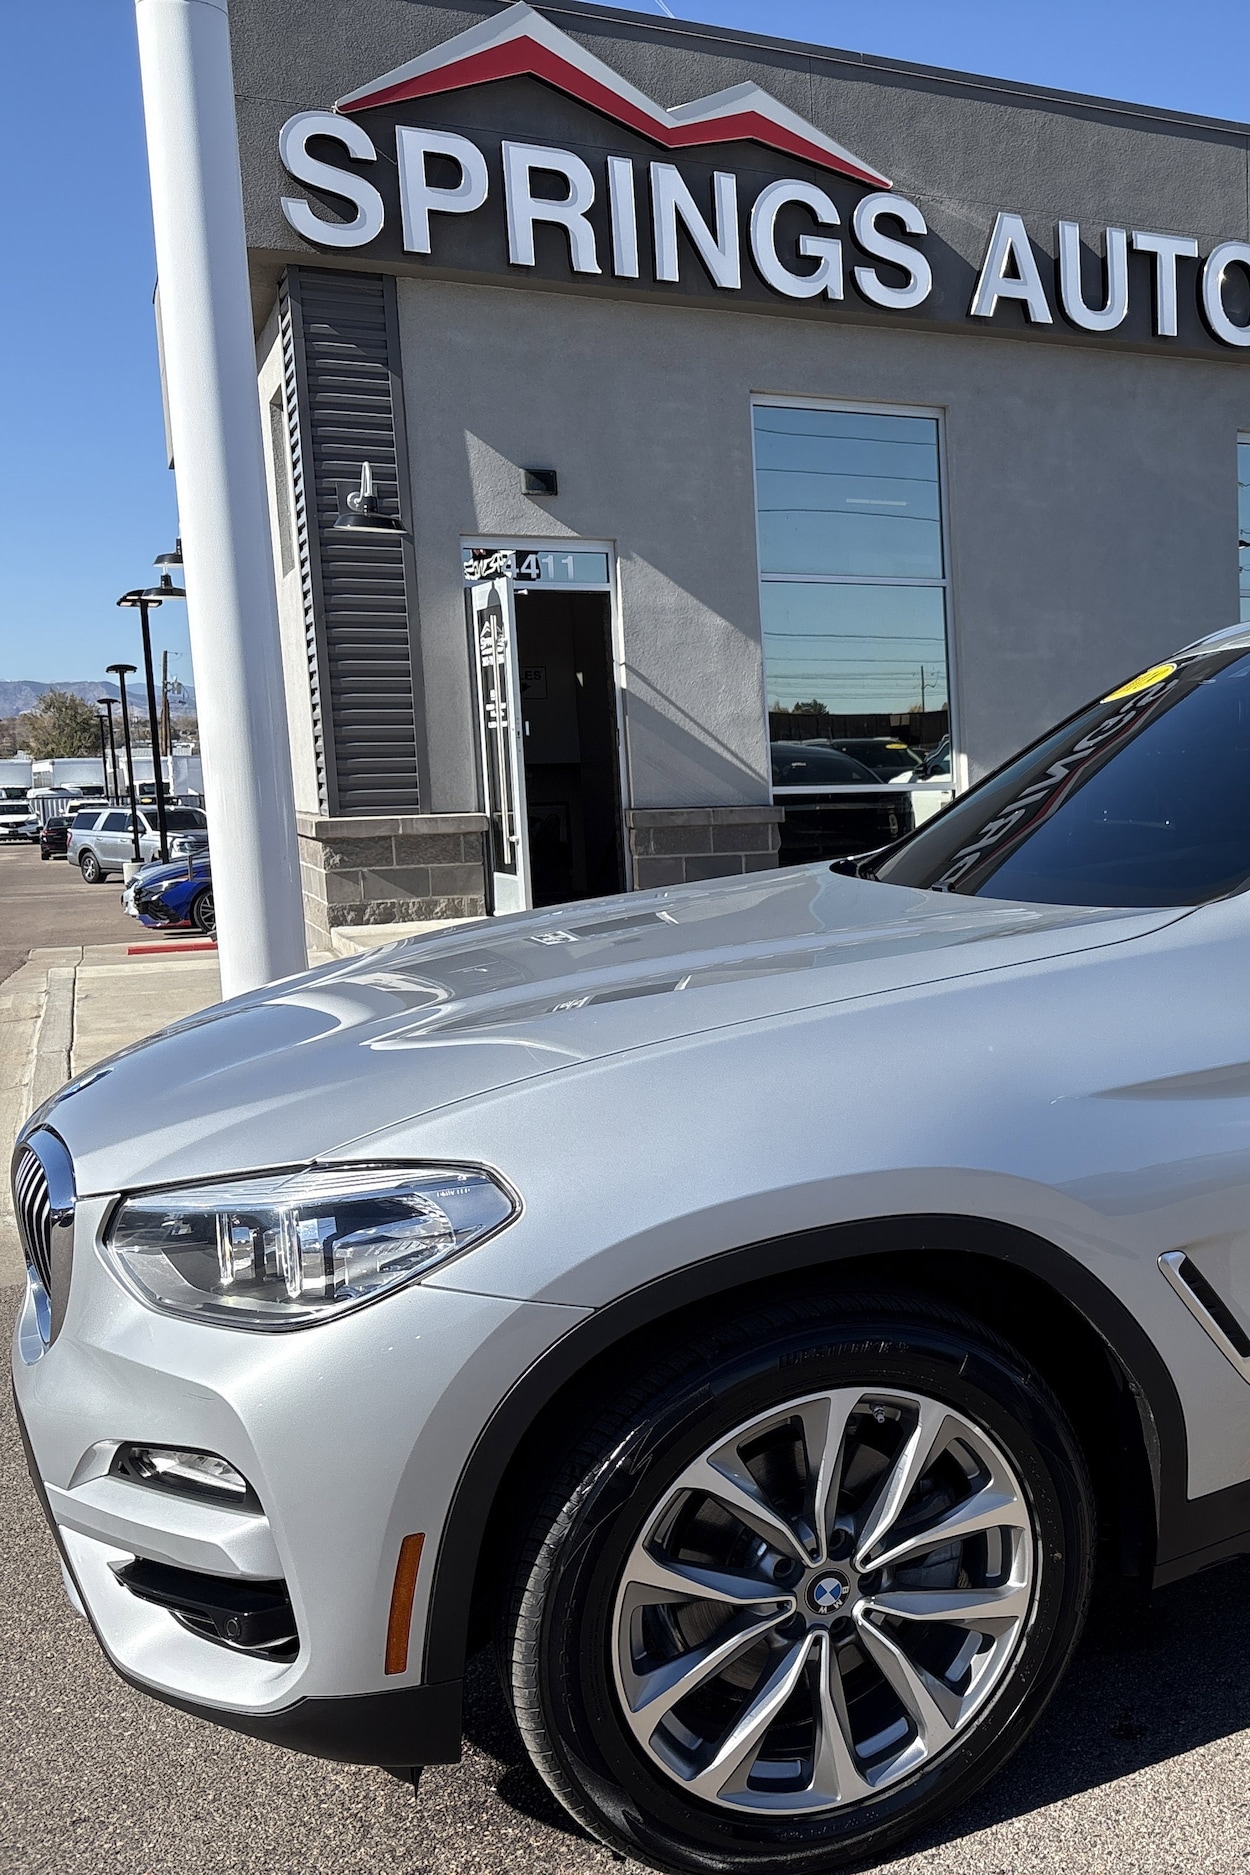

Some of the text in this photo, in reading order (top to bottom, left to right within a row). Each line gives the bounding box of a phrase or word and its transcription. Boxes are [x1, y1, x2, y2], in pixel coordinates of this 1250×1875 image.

[279, 110, 934, 310] SPRINGS
[500, 553, 575, 580] 4411
[818, 1585, 850, 1614] BMW
